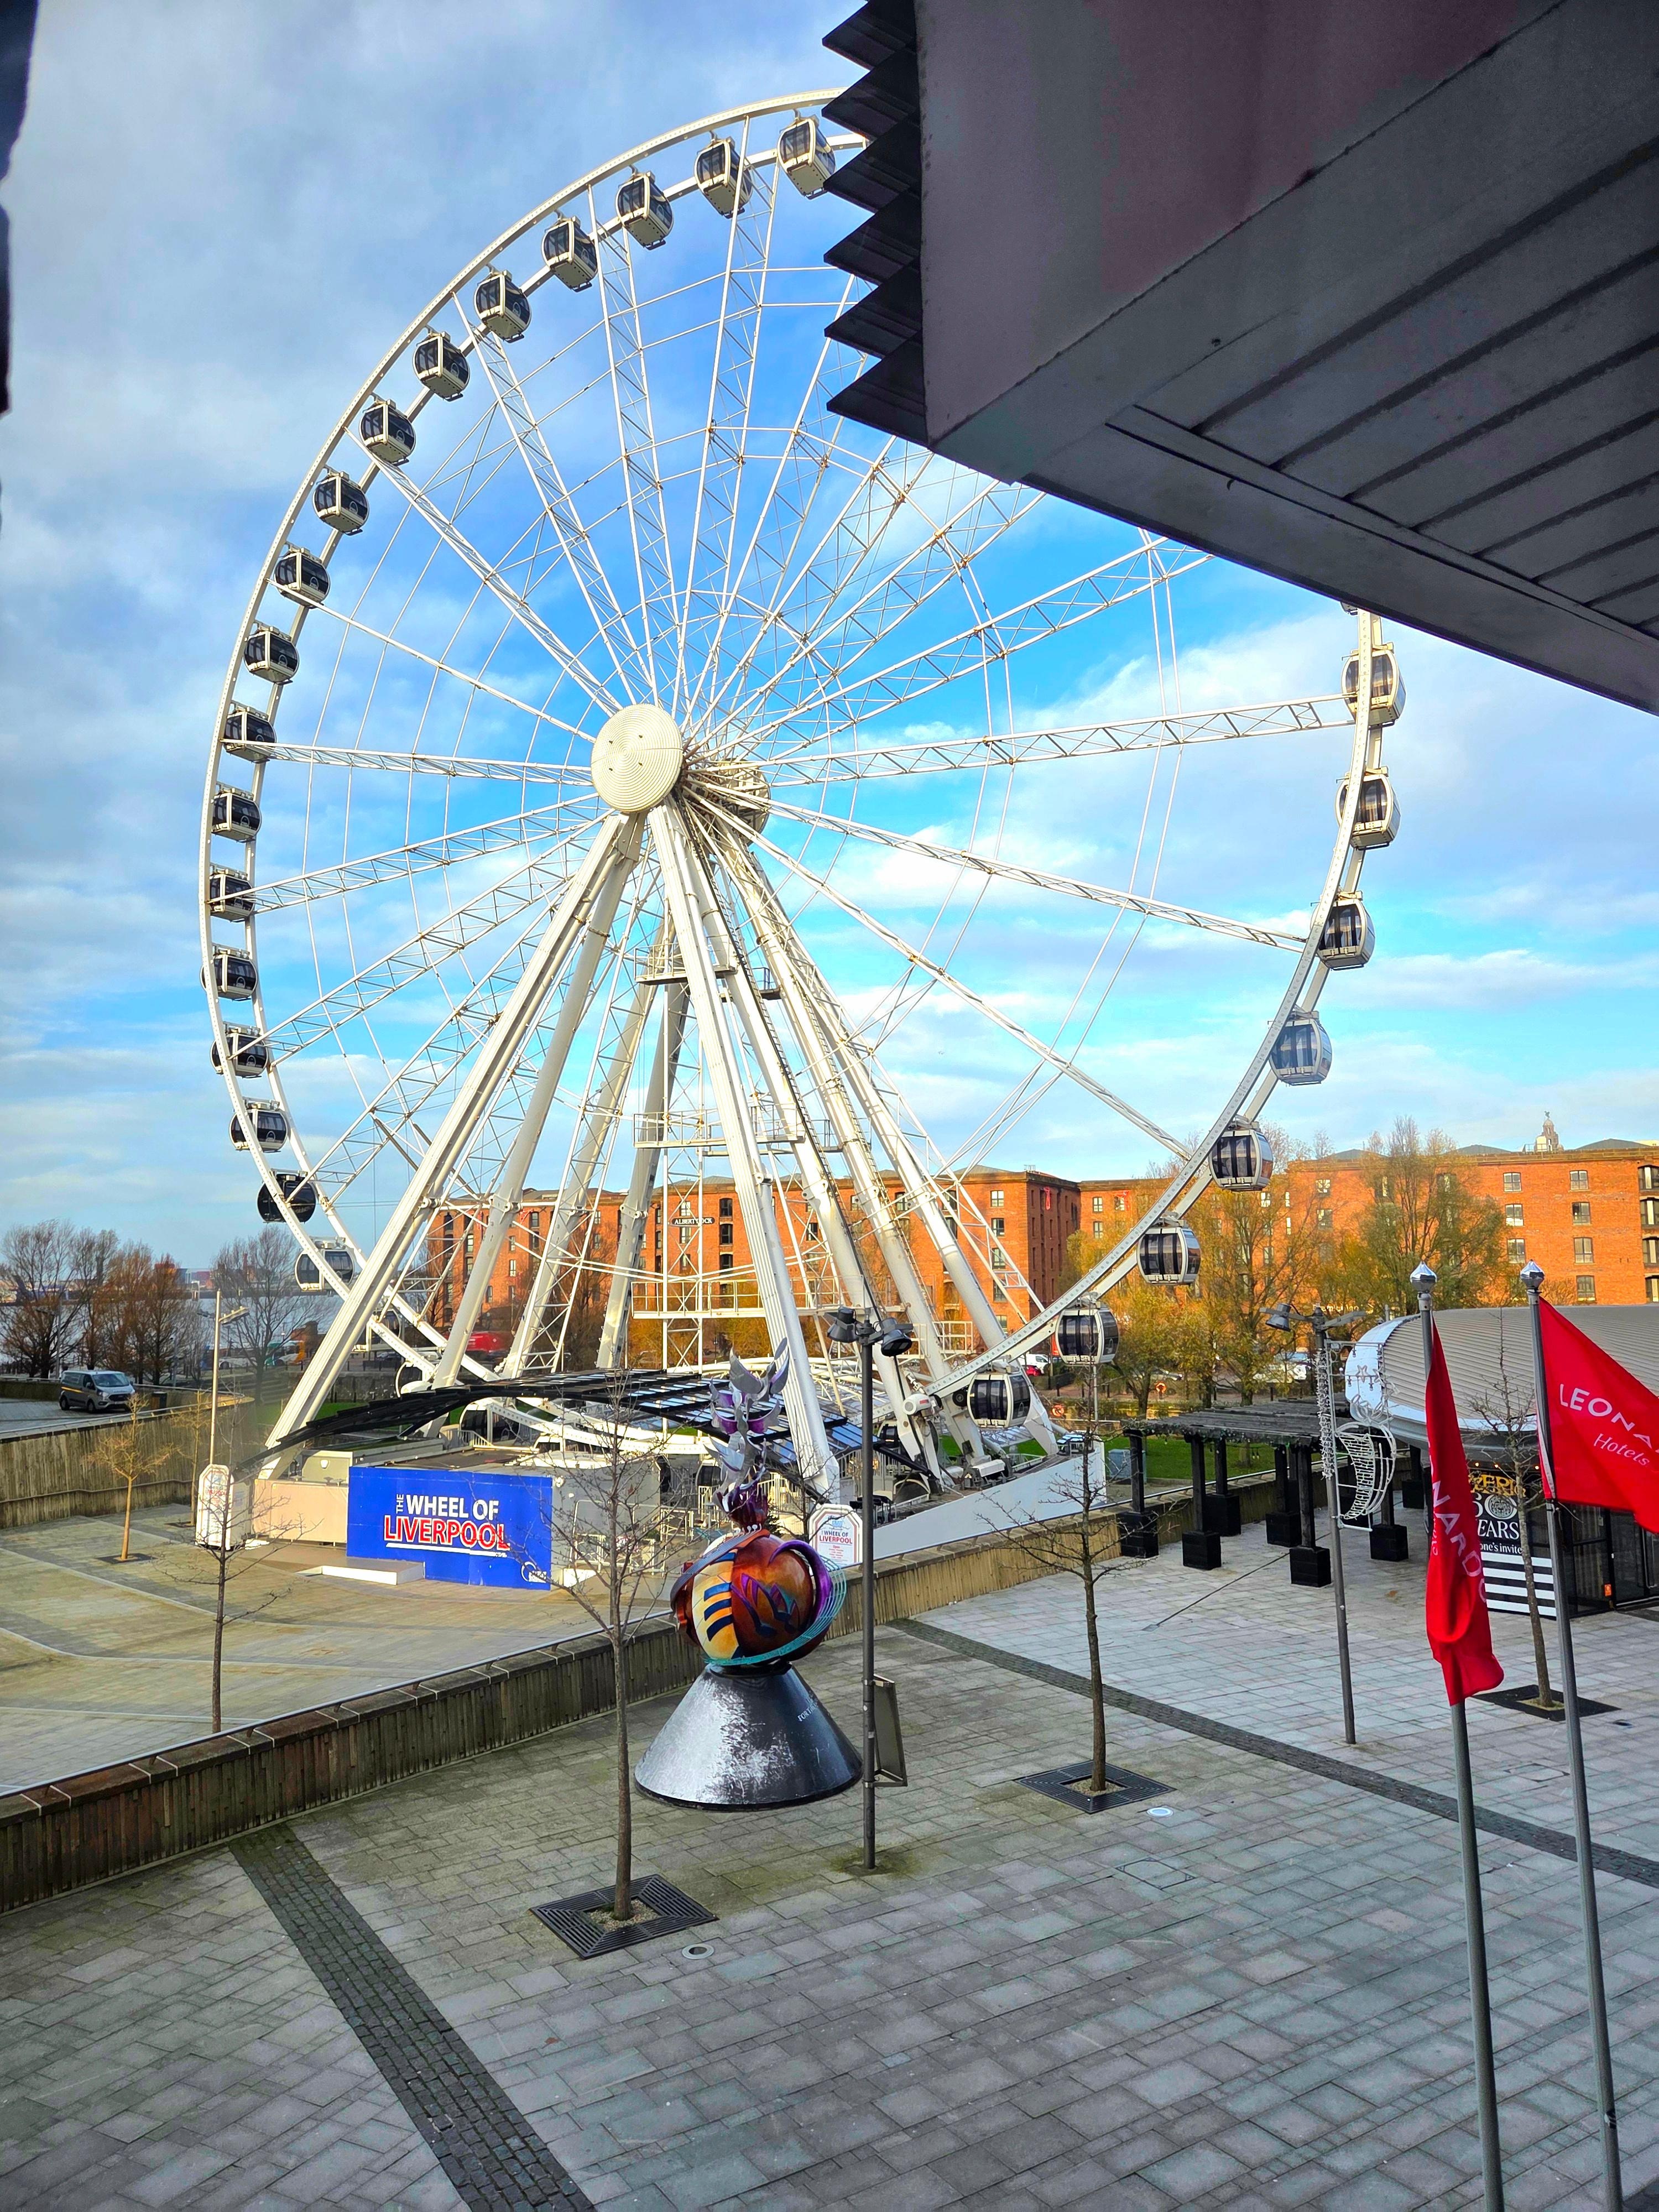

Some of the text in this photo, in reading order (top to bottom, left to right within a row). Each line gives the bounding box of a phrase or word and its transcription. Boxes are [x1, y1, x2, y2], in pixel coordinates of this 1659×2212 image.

[1559, 1383, 1659, 1454] LEONA
[1593, 1433, 1650, 1466] Hotels
[396, 1494, 404, 1514] THE
[406, 1494, 499, 1521] WHEEL OF
[384, 1515, 510, 1551] LIVERPOOL
[819, 1535, 853, 1545] LIVERPOOL
[1477, 1519, 1520, 1540] EARS
[1500, 1543, 1522, 1554] invite
